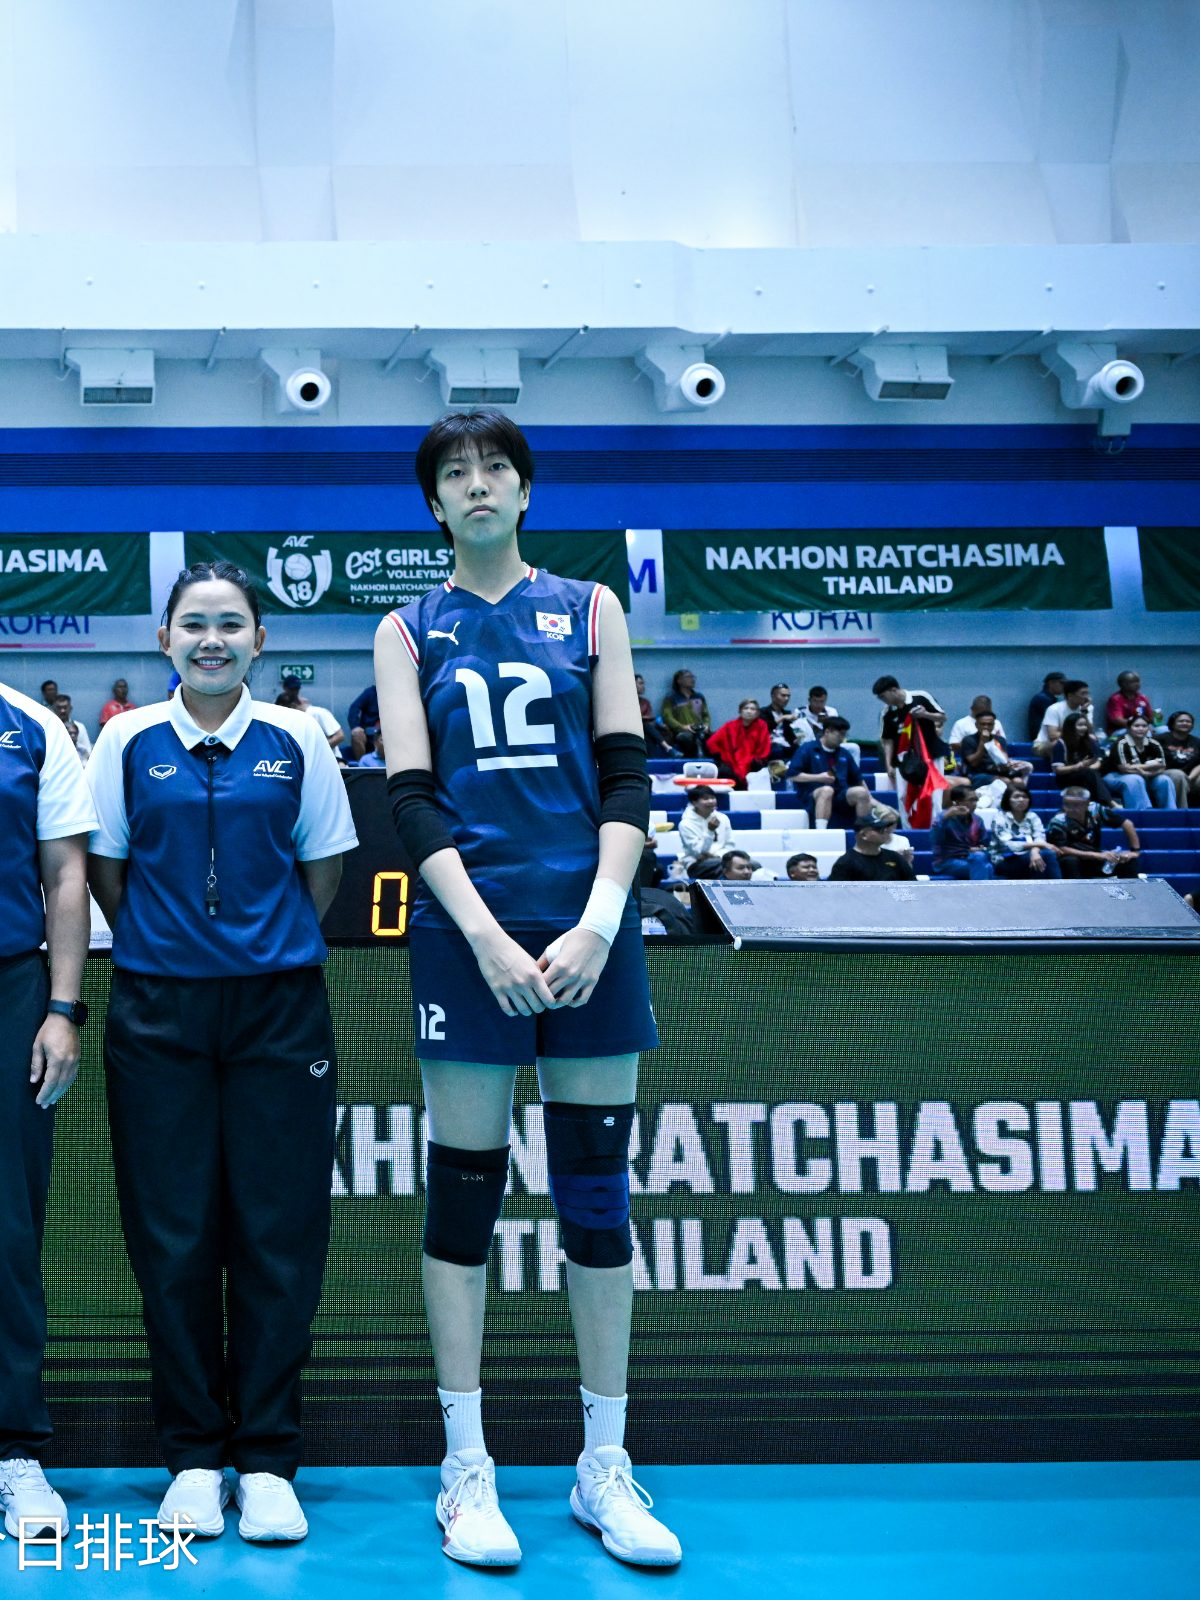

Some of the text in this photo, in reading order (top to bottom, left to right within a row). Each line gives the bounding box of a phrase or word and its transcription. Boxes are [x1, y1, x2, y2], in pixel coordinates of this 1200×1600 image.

[282, 535, 314, 548] AVC
[345, 548, 382, 579] est
[706, 543, 1065, 570] NAKHON RATCHASIMA
[387, 570, 454, 579] VOLLEYBAL
[287, 581, 312, 602] 18
[350, 583, 438, 591] NAKHON RATCHASIM
[823, 575, 953, 595] THAILAND
[371, 596, 394, 604] JULY
[546, 632, 564, 641] KOR
[455, 662, 556, 748] 12
[253, 760, 291, 773] AVC
[371, 872, 409, 936] 0
[419, 1003, 446, 1041] 12
